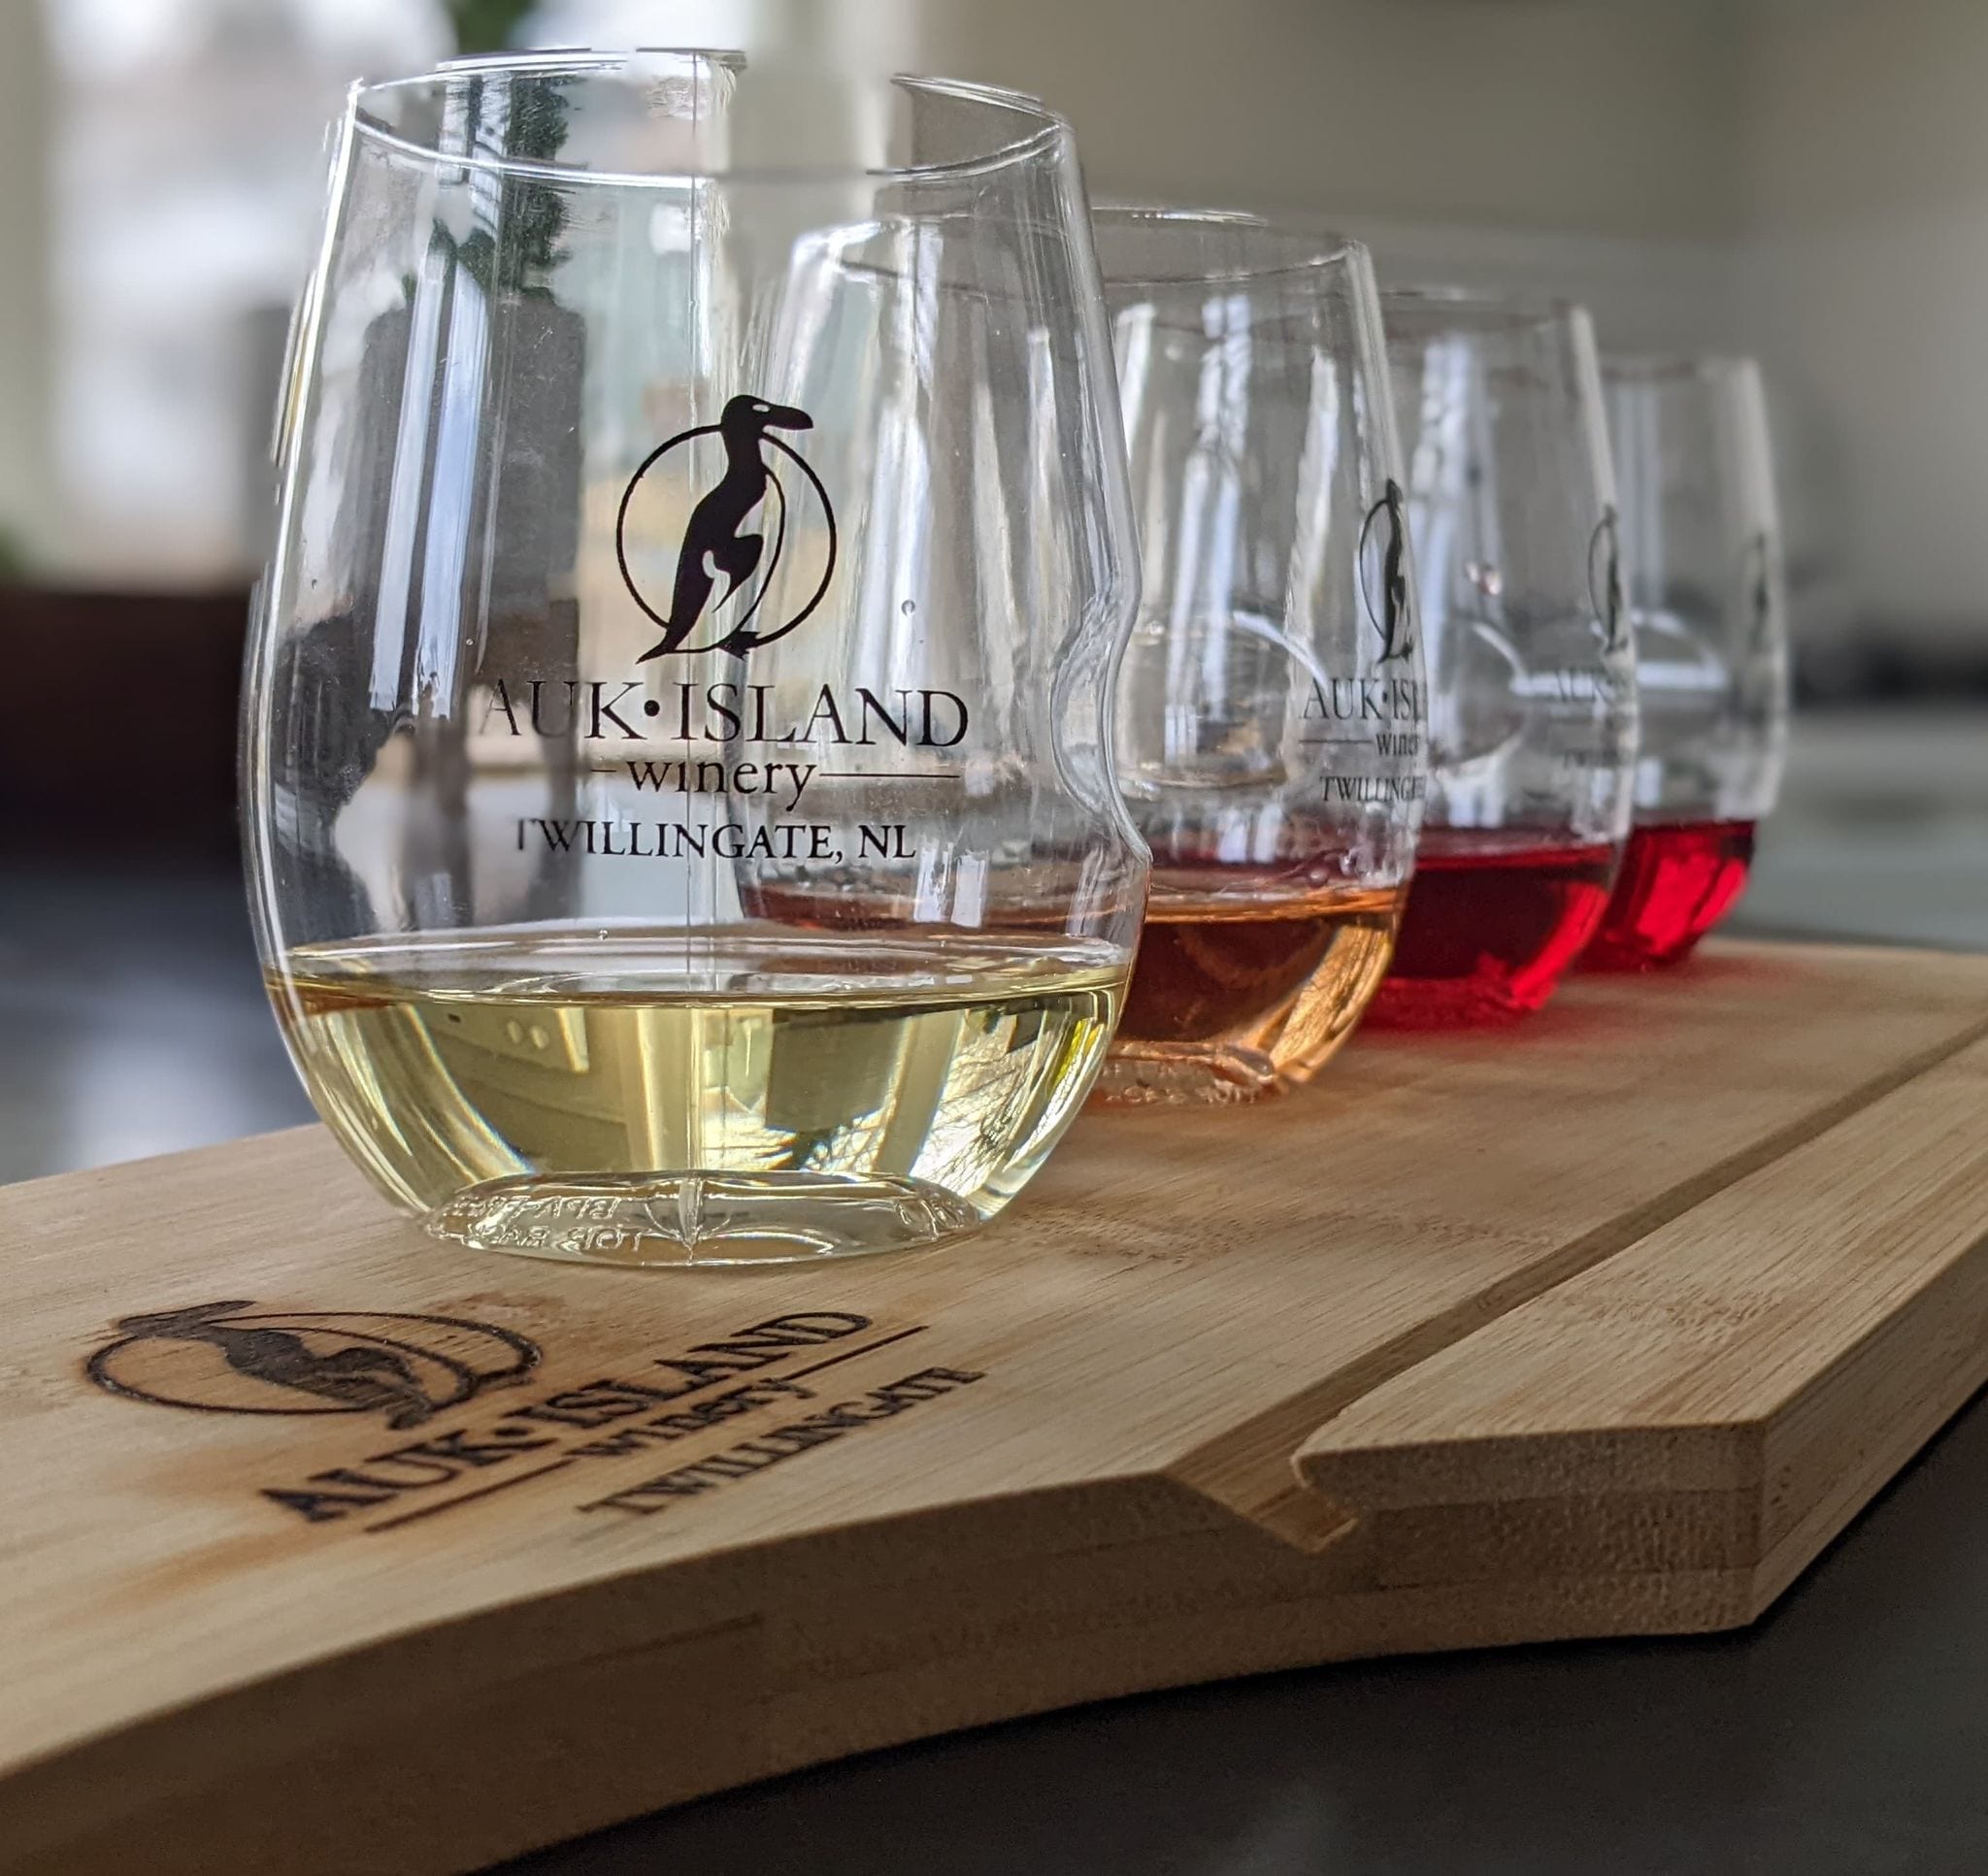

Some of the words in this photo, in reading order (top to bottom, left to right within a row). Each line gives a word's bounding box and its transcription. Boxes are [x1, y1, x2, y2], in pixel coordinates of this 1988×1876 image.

[626, 760, 817, 812] winery
[857, 823, 917, 860] NL
[566, 1377, 818, 1459] winery
